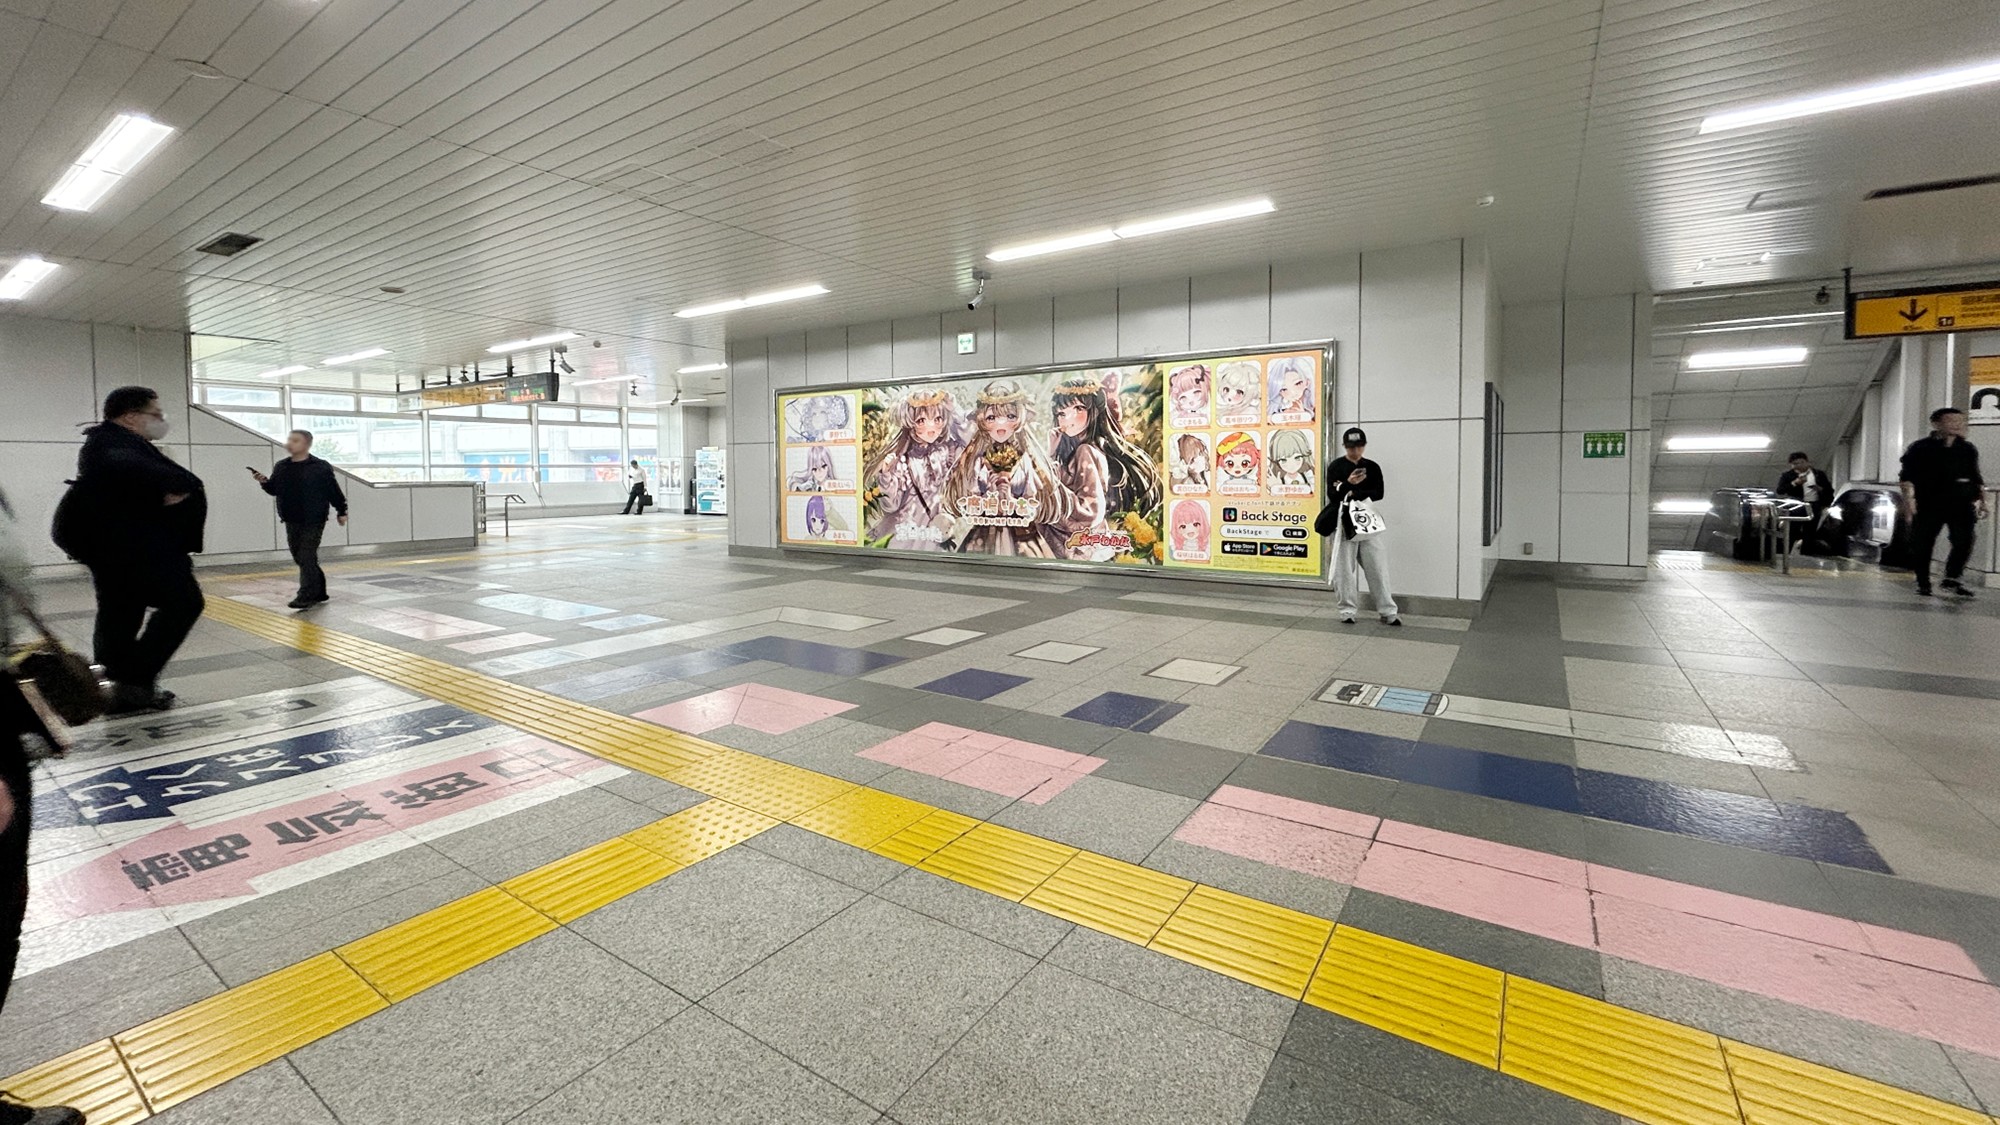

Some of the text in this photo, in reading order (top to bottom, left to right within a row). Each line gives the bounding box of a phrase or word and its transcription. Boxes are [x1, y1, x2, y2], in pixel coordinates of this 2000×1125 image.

[1226, 528, 1263, 537] BackStage
[1241, 510, 1307, 525] Back Stage
[1273, 544, 1306, 553] Google Play
[68, 746, 286, 802] つくば
[79, 718, 477, 820] エクスプレス
[121, 746, 574, 892] 電気街口
